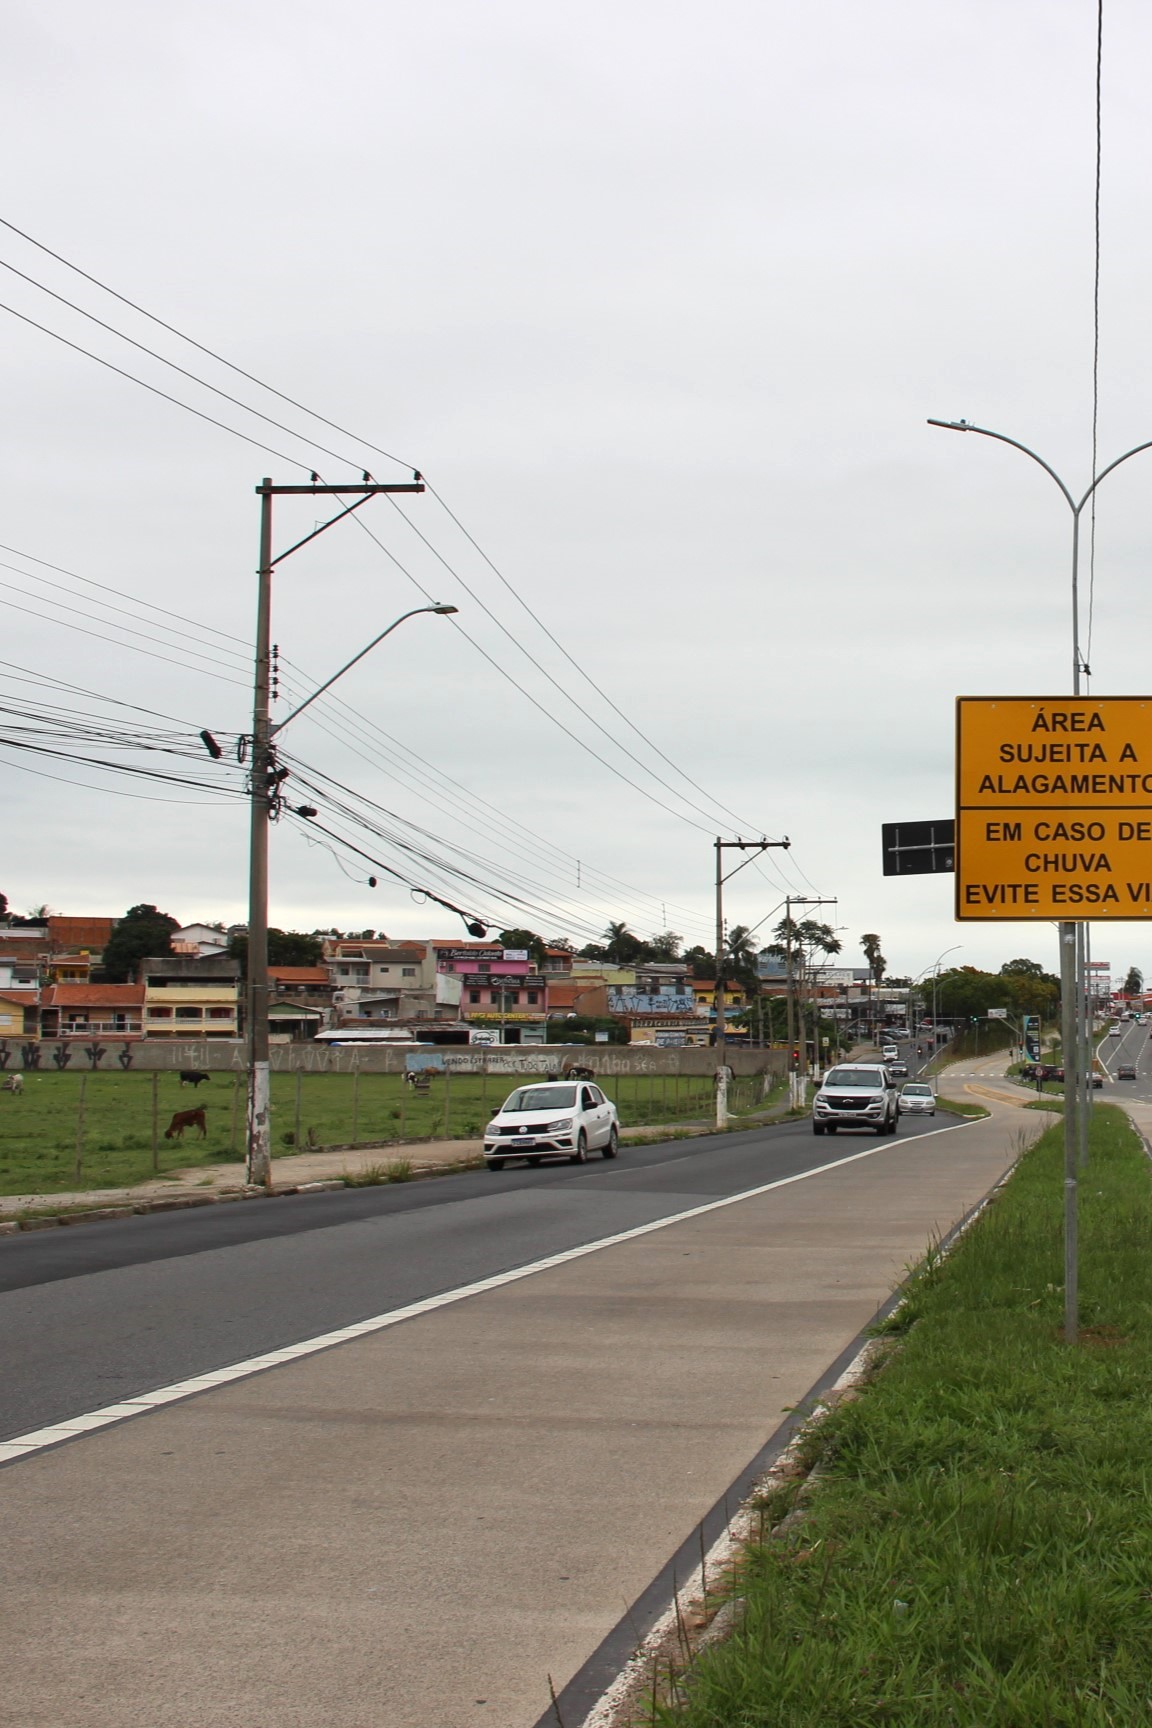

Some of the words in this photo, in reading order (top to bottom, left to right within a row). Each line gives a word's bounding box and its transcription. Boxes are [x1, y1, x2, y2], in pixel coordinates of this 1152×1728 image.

[1031, 707, 1106, 733] ÁREA
[999, 743, 1108, 763] SUJEITA
[1119, 743, 1138, 763] A
[985, 822, 1022, 842] EM
[1033, 822, 1106, 842] CASO
[1118, 821, 1152, 841] DE
[1024, 852, 1112, 873] CHUVA
[965, 883, 1040, 905] EVITE
[1051, 883, 1120, 904] ESSA
